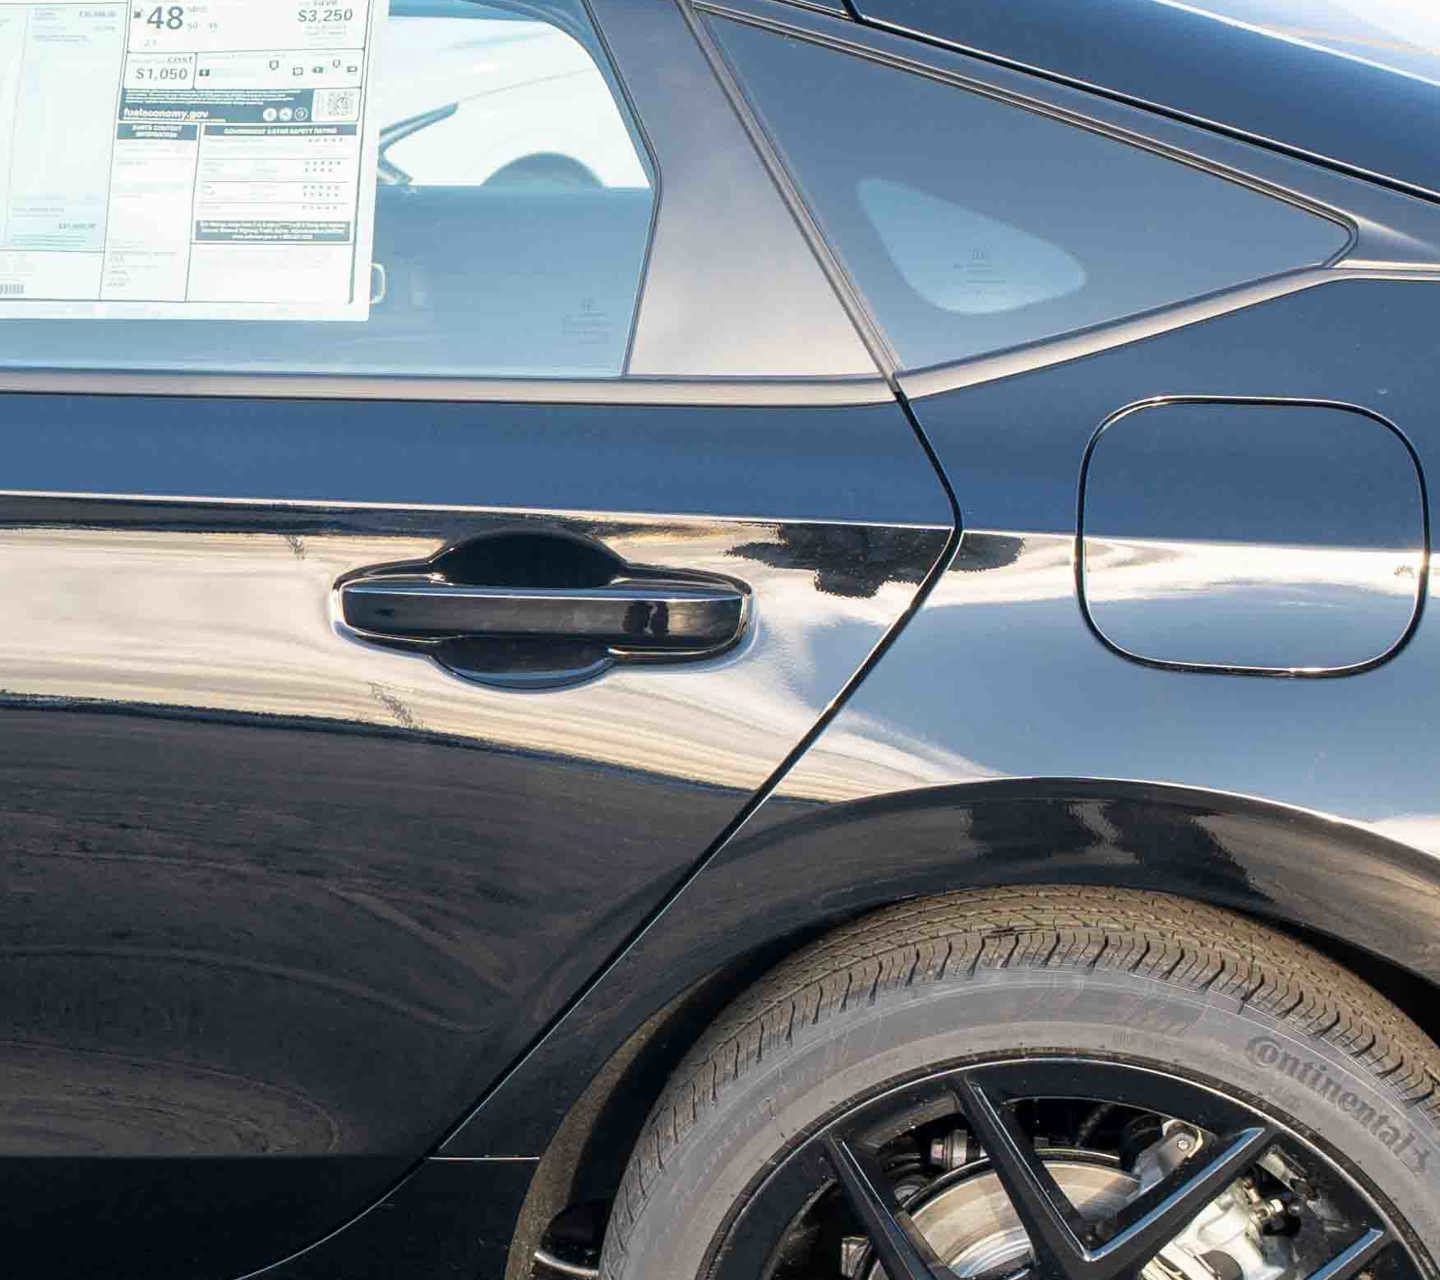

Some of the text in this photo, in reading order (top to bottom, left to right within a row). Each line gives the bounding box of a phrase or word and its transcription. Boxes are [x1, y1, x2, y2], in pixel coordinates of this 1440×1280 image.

[146, 5, 185, 30] 48
[297, 7, 353, 23] $3,250
[135, 67, 189, 81] $1,050
[1245, 1035, 1417, 1155] Continental
